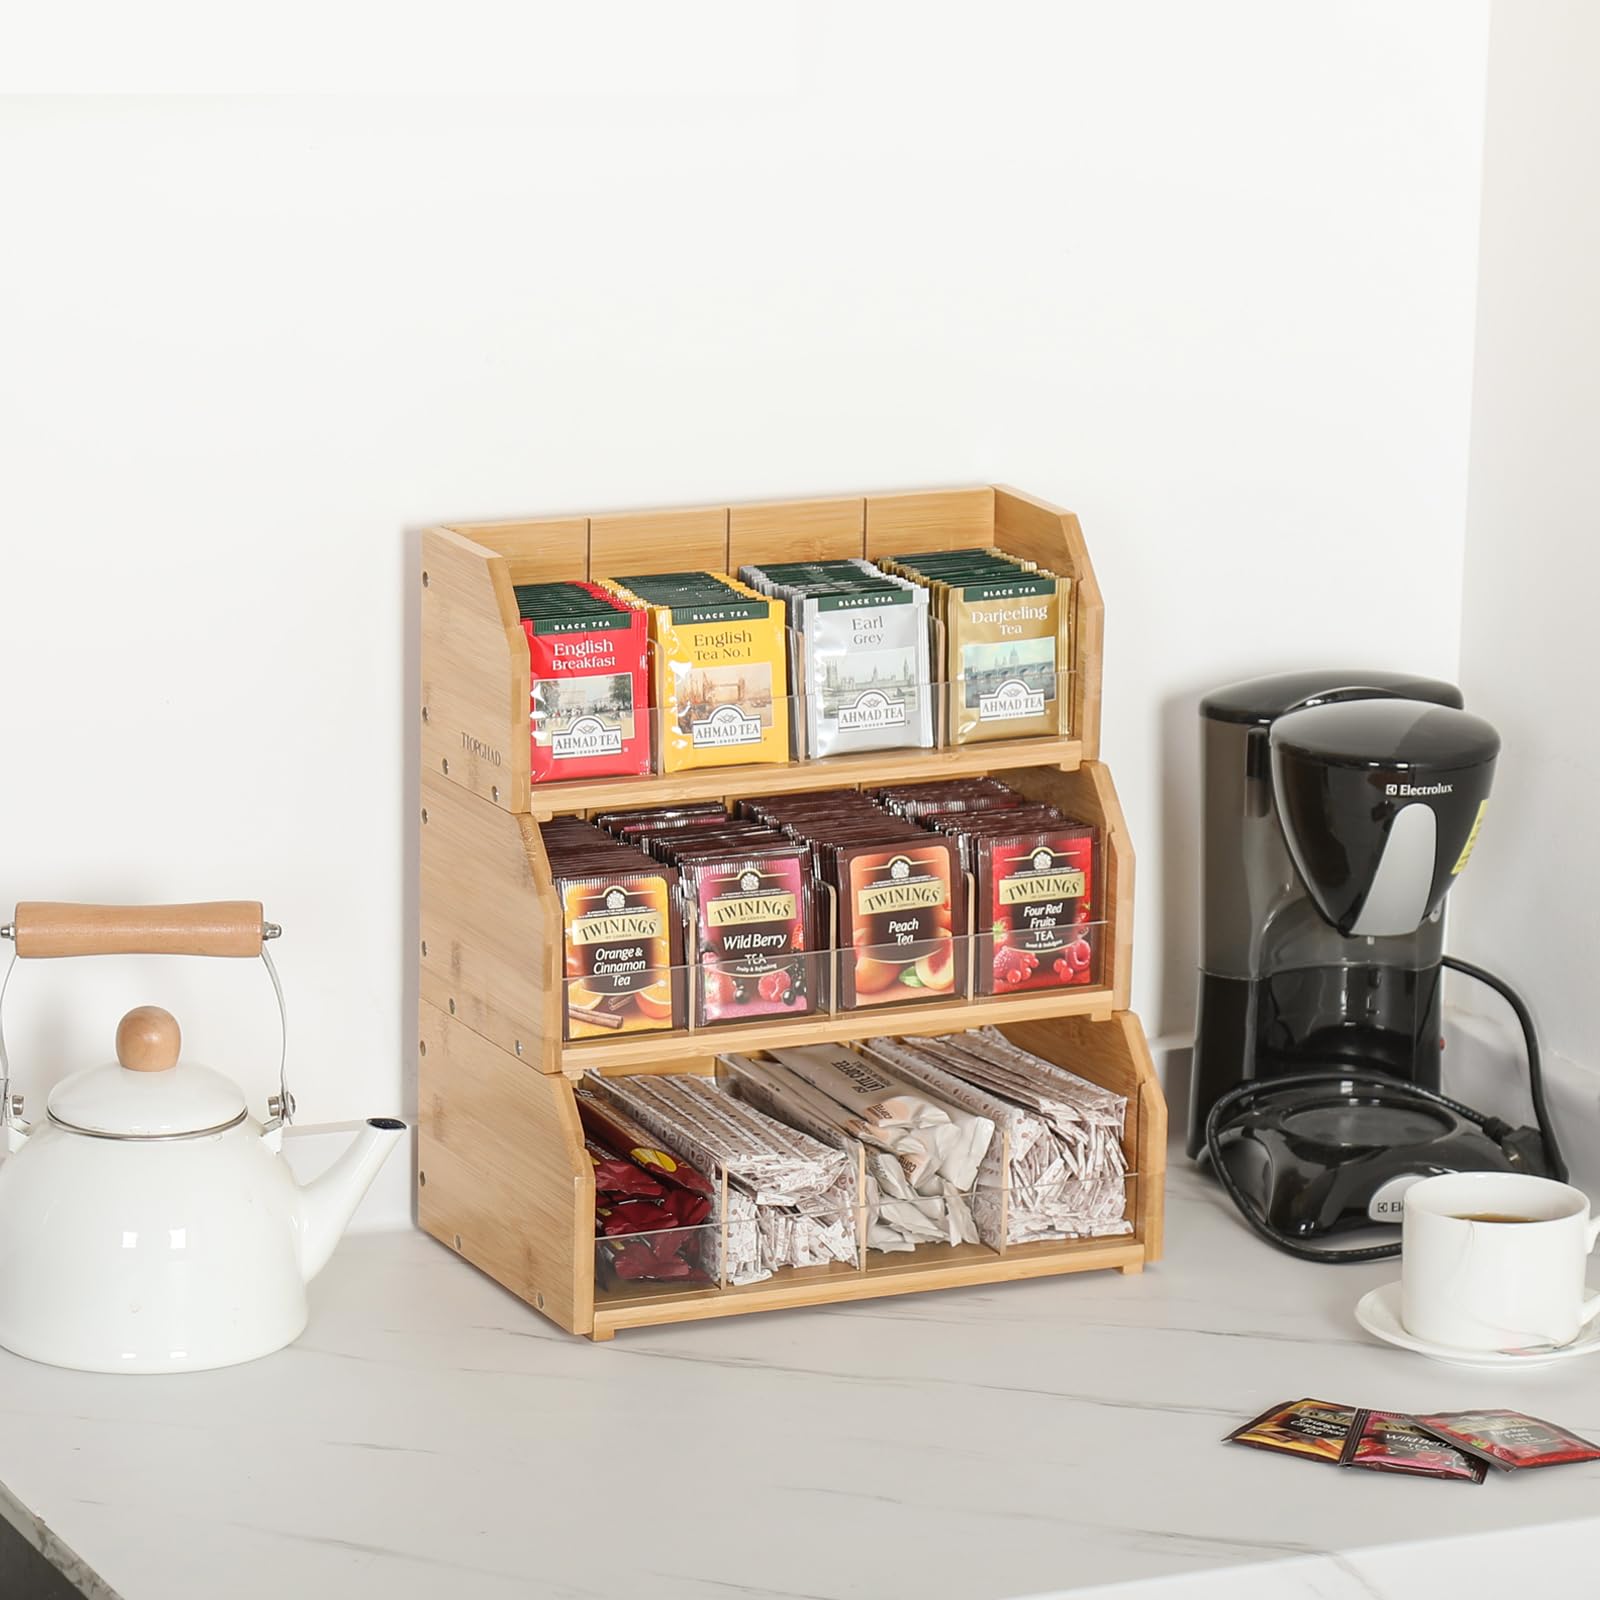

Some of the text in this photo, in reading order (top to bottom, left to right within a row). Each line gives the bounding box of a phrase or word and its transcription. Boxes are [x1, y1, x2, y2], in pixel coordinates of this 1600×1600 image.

[983, 589, 1013, 597] BLACK
[838, 599, 870, 607] BLACK
[693, 612, 725, 620] BLACK
[971, 605, 1048, 625] Darjeeling
[553, 622, 586, 631] BLACK
[852, 615, 884, 631] Earl
[1001, 624, 1023, 636] Tea
[694, 630, 752, 648] English
[853, 634, 884, 645] Grey
[554, 639, 614, 657] English
[694, 650, 719, 661] Tea
[552, 655, 616, 671] Breakfast
[982, 697, 1043, 713] AHMAD TEA
[840, 706, 904, 724] AHMAD TEA
[695, 722, 759, 739] AHMAD TEA
[555, 733, 620, 750] AHMAD TEA
[1400, 783, 1453, 796] Electrolux
[1006, 878, 1080, 901] TWININGS
[865, 887, 940, 911] TWININGS
[714, 900, 791, 923] TWININGS
[1023, 903, 1063, 917] Four Red
[579, 918, 656, 941] TWININGS
[888, 918, 919, 933] Peach
[1030, 917, 1056, 929] Fruits
[723, 934, 787, 950] Wild Berry
[895, 933, 914, 946] Tea
[1034, 930, 1055, 941] TEA
[595, 947, 643, 961] Orange &
[744, 954, 767, 965] TEA
[593, 960, 646, 975] Cinnamon
[612, 975, 630, 987] Tea
